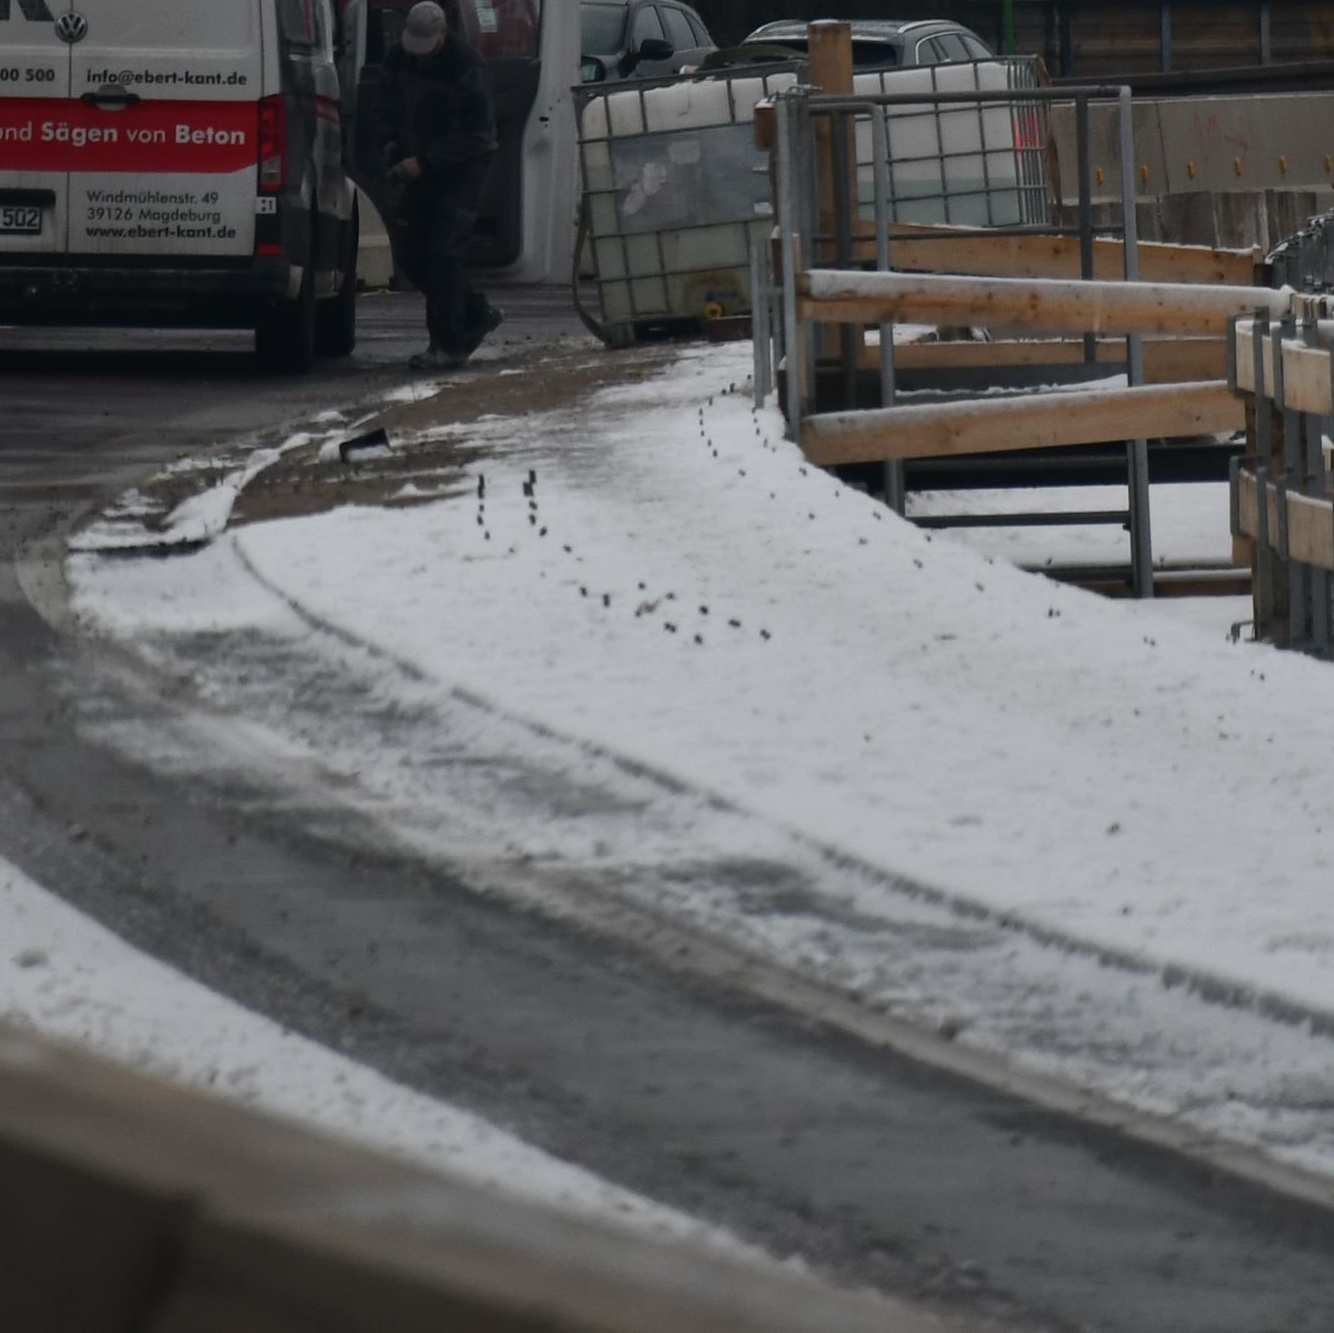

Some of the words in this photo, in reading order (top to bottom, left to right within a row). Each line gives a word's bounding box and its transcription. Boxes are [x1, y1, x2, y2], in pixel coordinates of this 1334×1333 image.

[25, 68, 55, 82] 500
[86, 69, 248, 86] info@ebert-kant.de
[41, 122, 118, 147] Sägen
[126, 129, 166, 143] von
[175, 124, 246, 146] Beton
[87, 190, 198, 205] Windmühlenstr.
[202, 191, 219, 205] 49
[3, 208, 38, 227] 502
[87, 207, 133, 221] 39126
[139, 207, 221, 225] Magdeburg
[85, 224, 236, 239] www.ebert-kant.de
